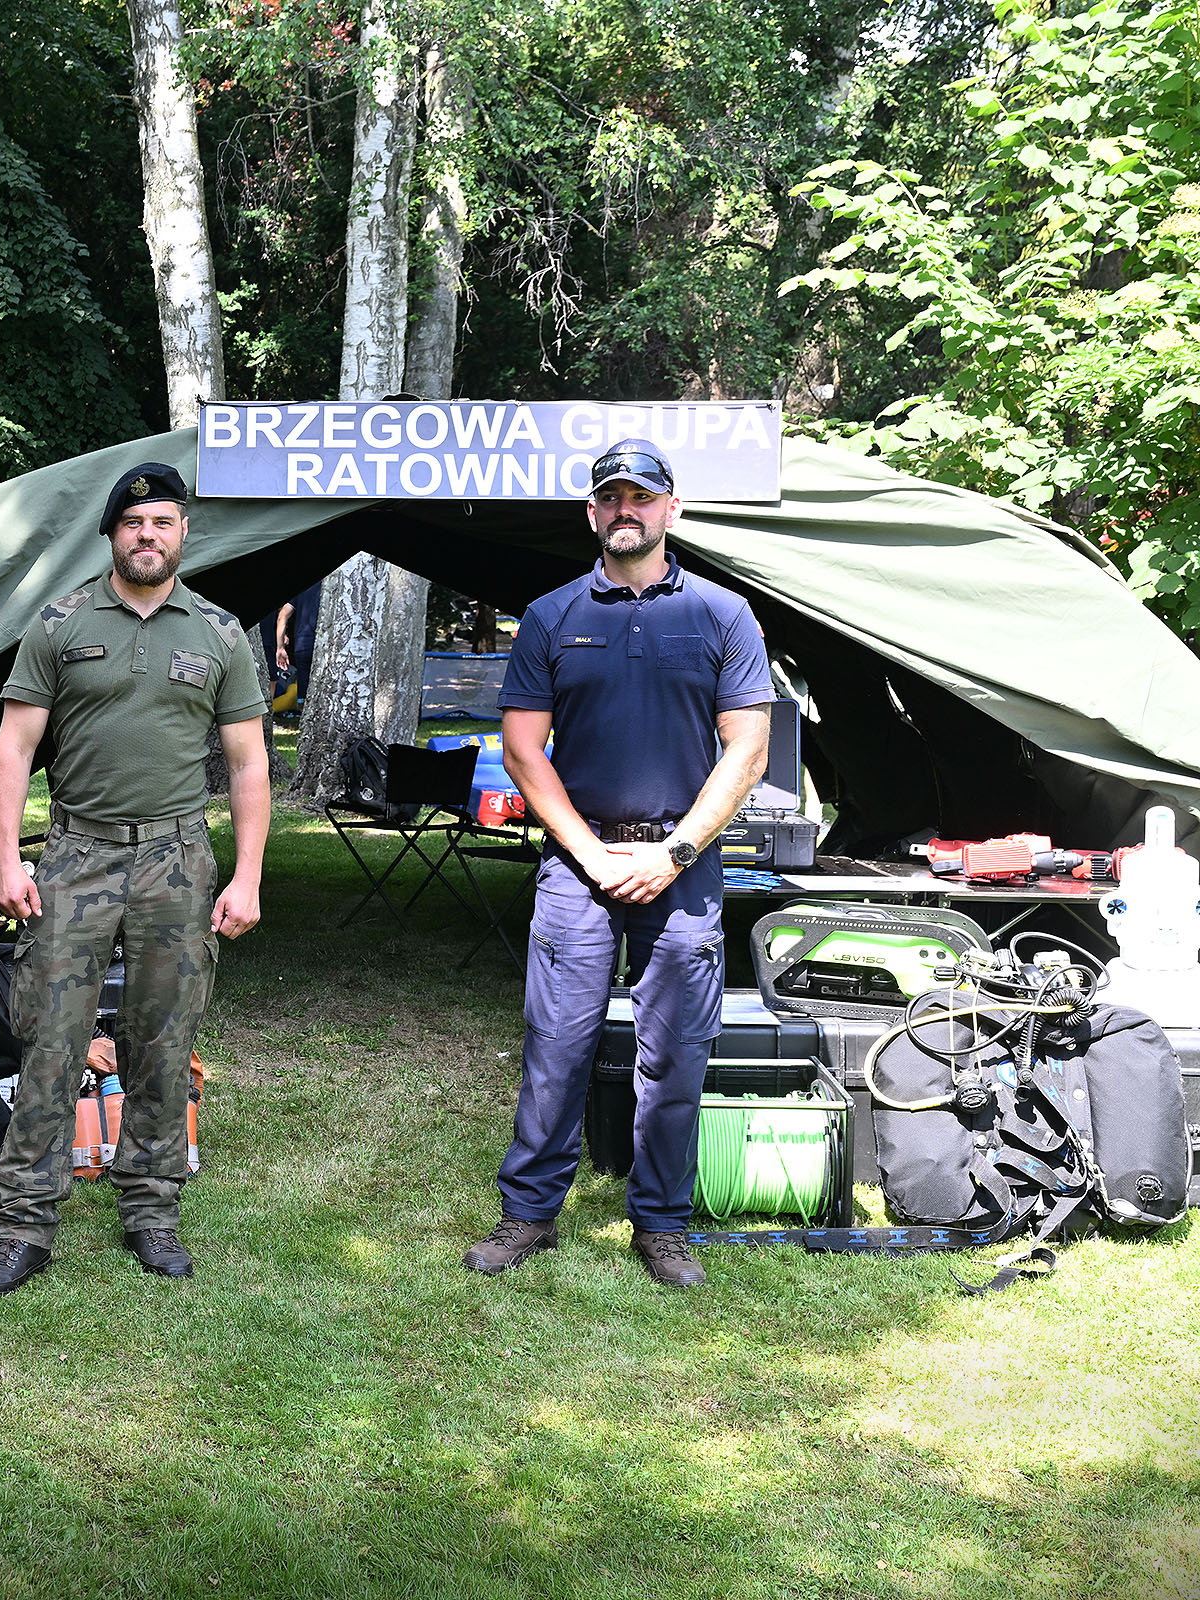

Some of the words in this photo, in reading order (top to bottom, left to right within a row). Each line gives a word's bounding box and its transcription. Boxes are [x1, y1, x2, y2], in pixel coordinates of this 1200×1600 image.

[205, 403, 545, 450] BRZEGOWA
[560, 403, 772, 450] GRUPA
[285, 452, 599, 498] RATOWNIC
